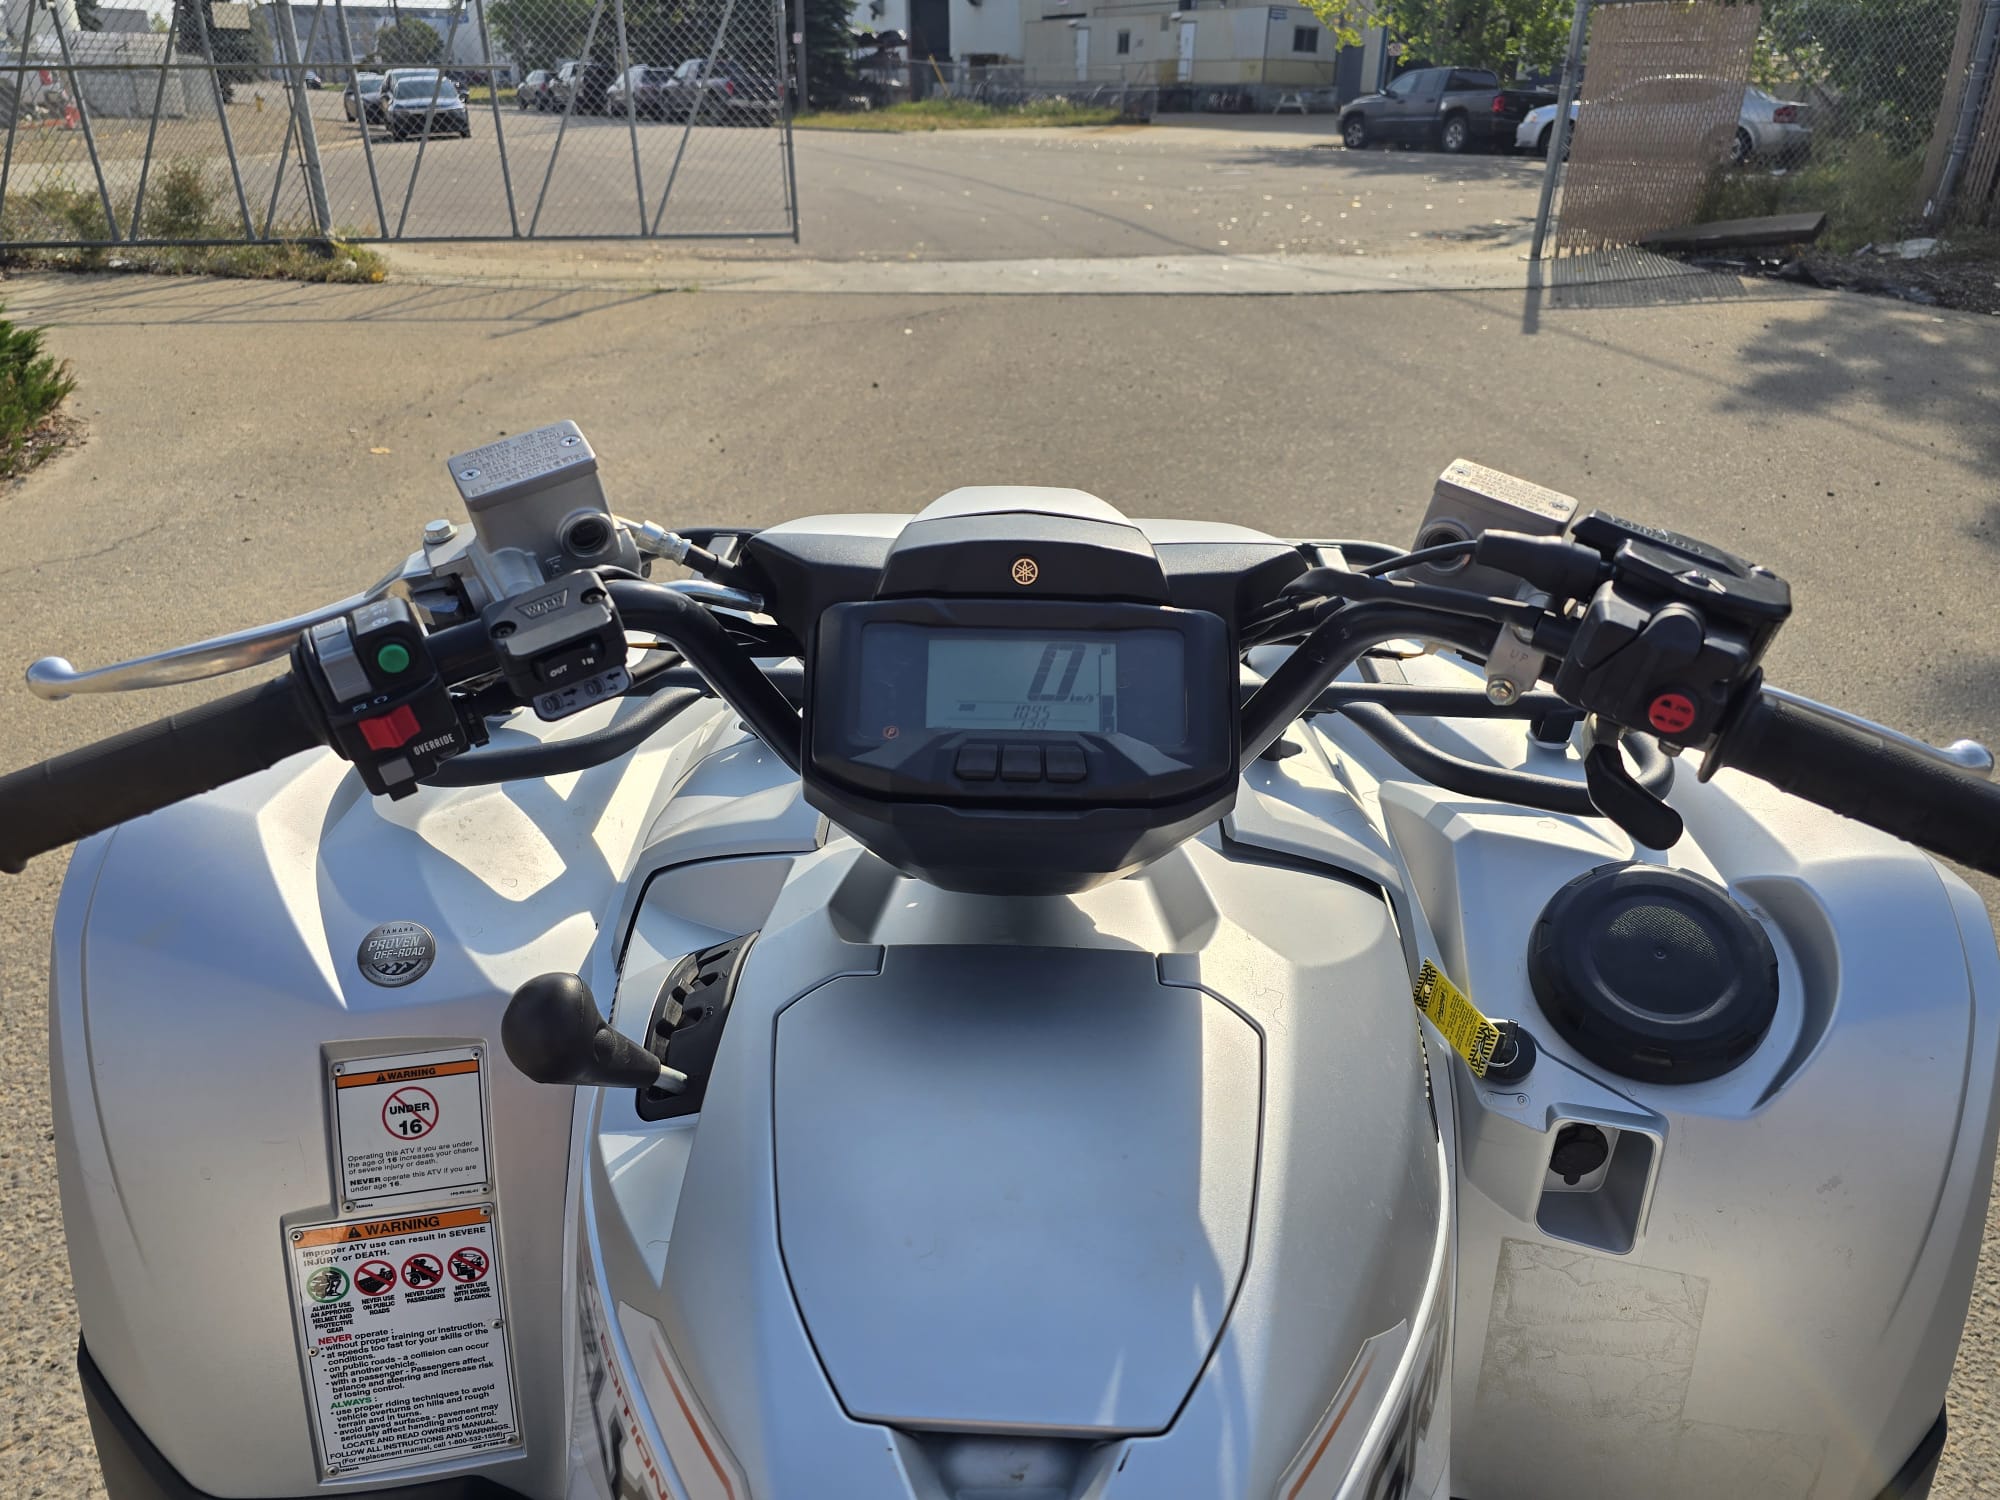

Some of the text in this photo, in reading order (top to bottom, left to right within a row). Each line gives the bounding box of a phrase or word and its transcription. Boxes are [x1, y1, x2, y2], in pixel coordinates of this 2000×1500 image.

[550, 664, 568, 678] OUT
[1027, 643, 1086, 701] 0
[413, 733, 455, 756] OVERRIDE
[368, 936, 420, 952] PROVEN
[373, 946, 425, 960] OFF-ROAD
[386, 1067, 436, 1080] WARNING
[389, 1102, 429, 1114] UNDER
[398, 1117, 422, 1135] 16
[347, 1152, 383, 1162] Operating
[399, 1152, 433, 1161] increases
[453, 1146, 478, 1154] chance
[357, 1165, 382, 1173] severe
[349, 1176, 380, 1186] NEVER
[382, 1173, 410, 1182] operate
[364, 1215, 440, 1235] WARNING
[302, 1247, 345, 1257] Improper
[348, 1242, 366, 1251] ATV
[408, 1233, 435, 1243] result
[449, 1226, 485, 1237] SEVERE
[304, 1255, 339, 1266] INJURY
[354, 1248, 389, 1259] DEATH.
[404, 1290, 424, 1298] NEVER
[454, 1283, 474, 1291] NEVER
[312, 1303, 337, 1312] ALWAYS
[361, 1296, 381, 1304] NEVER
[373, 1300, 395, 1308] PUBLIC
[320, 1306, 354, 1316] APPROVED
[369, 1307, 390, 1315] ROADS
[312, 1315, 337, 1324] HELMET
[314, 1319, 353, 1329] PROTECTIVE
[318, 1329, 388, 1345] NEVER operate
[325, 1340, 358, 1351] without
[360, 1336, 389, 1347] proper
[391, 1331, 424, 1340] training
[437, 1322, 485, 1333] instruction.
[337, 1346, 369, 1357] speeds
[386, 1340, 403, 1348] fast
[418, 1336, 438, 1345] your
[440, 1332, 462, 1340] skills
[327, 1353, 375, 1365] conditions.
[342, 1360, 369, 1371] public
[370, 1356, 395, 1365] roads
[410, 1349, 445, 1359] collision
[465, 1342, 488, 1350] occur
[329, 1360, 417, 1379] with another vehicle.
[330, 1378, 349, 1386] with
[358, 1369, 404, 1382] passenger
[410, 1360, 460, 1373] Passengers
[462, 1355, 485, 1364] affect
[332, 1382, 366, 1393] balance
[368, 1378, 384, 1387] and
[386, 1373, 420, 1384] steering
[423, 1369, 438, 1378] and
[440, 1365, 476, 1375] increase
[344, 1389, 370, 1398] losing
[372, 1382, 404, 1393] control.
[354, 1402, 383, 1413] proper
[385, 1398, 410, 1407] riding
[411, 1390, 459, 1402] techniques
[472, 1383, 494, 1392] avoid
[330, 1396, 372, 1409] ALWAYS
[336, 1412, 367, 1422] vehicle
[369, 1405, 411, 1416] overturns
[426, 1399, 444, 1407] hills
[446, 1395, 462, 1403] and
[464, 1391, 489, 1400] rough
[337, 1419, 366, 1428] terrain
[368, 1415, 384, 1423] and
[396, 1410, 421, 1418] turns.
[339, 1403, 498, 1435] avoid paved surfaces pavement may
[340, 1410, 496, 1441] seriously affect handling and control.
[329, 1423, 510, 1459] FOLLOW ALL INSTRUCTIONS AND WARNINGS.
[342, 1418, 498, 1449] LOCATE AND READ OWNER'S MANUAL.
